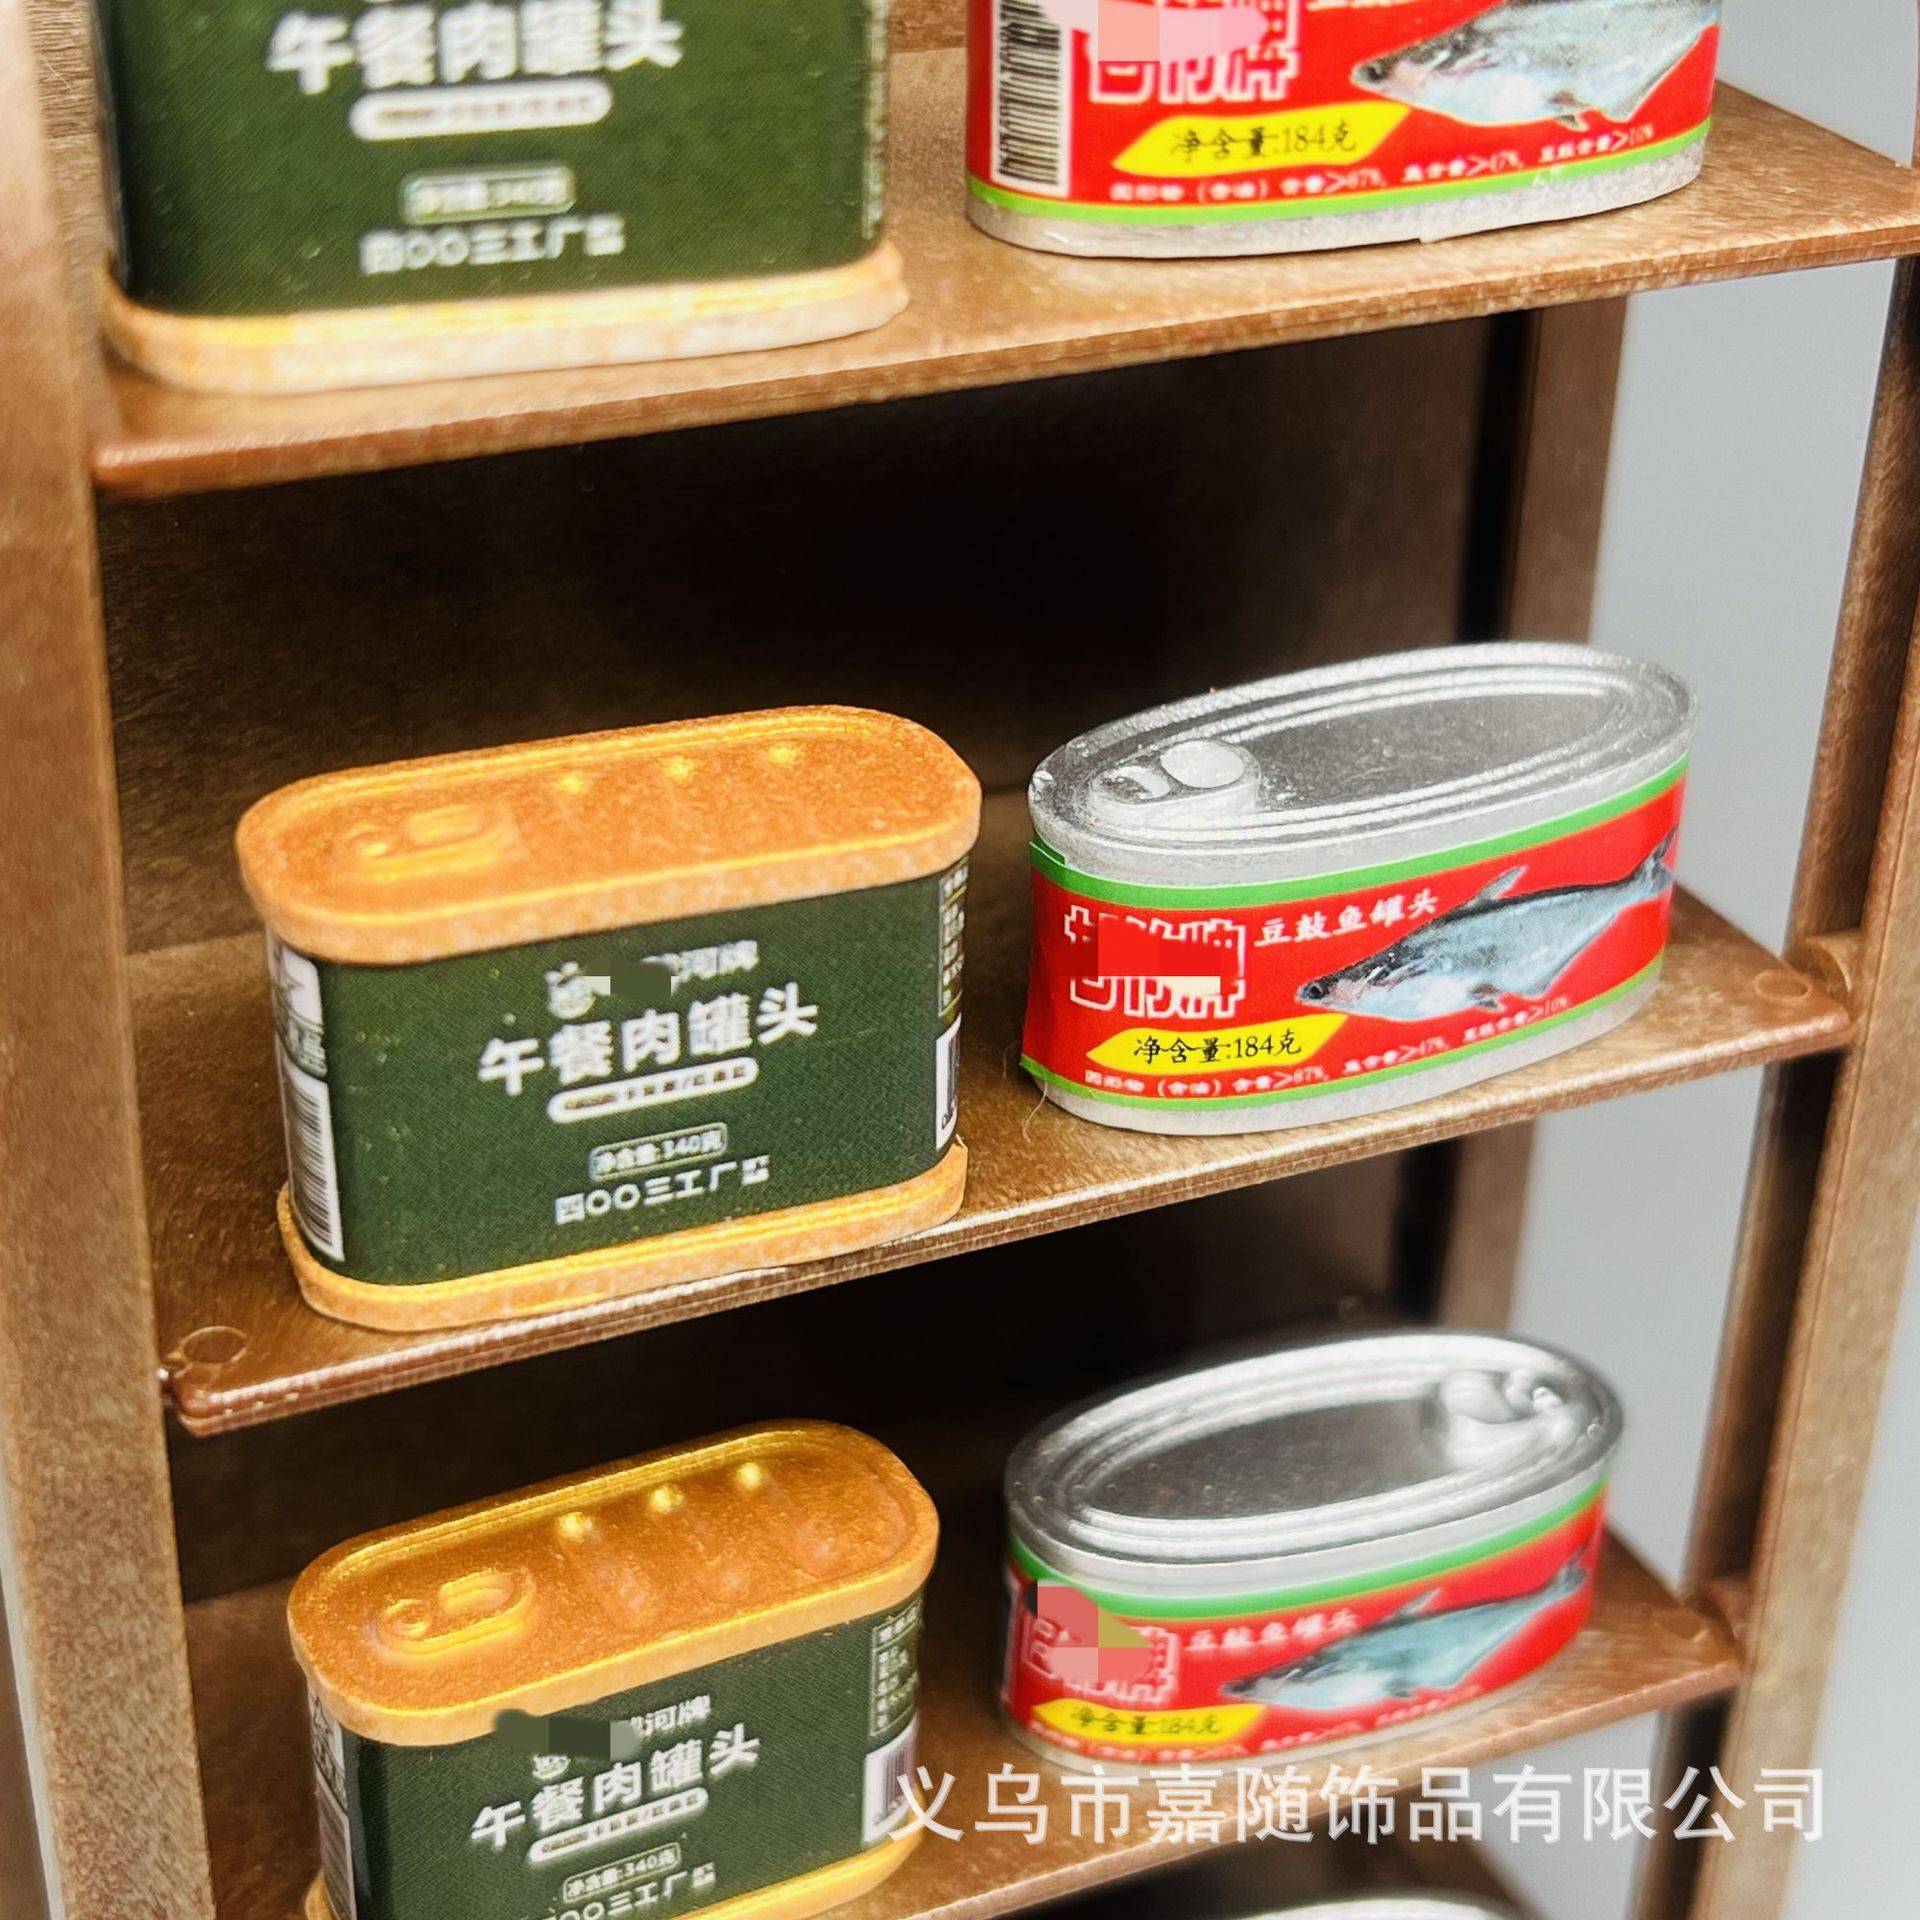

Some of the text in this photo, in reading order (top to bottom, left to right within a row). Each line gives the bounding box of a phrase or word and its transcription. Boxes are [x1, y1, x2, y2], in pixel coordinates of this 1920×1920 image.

[477, 981, 819, 1096] 午餐肉罐头
[1133, 1029, 1302, 1064] 净含量:184克
[470, 1722, 762, 1850] 午餐肉罐头
